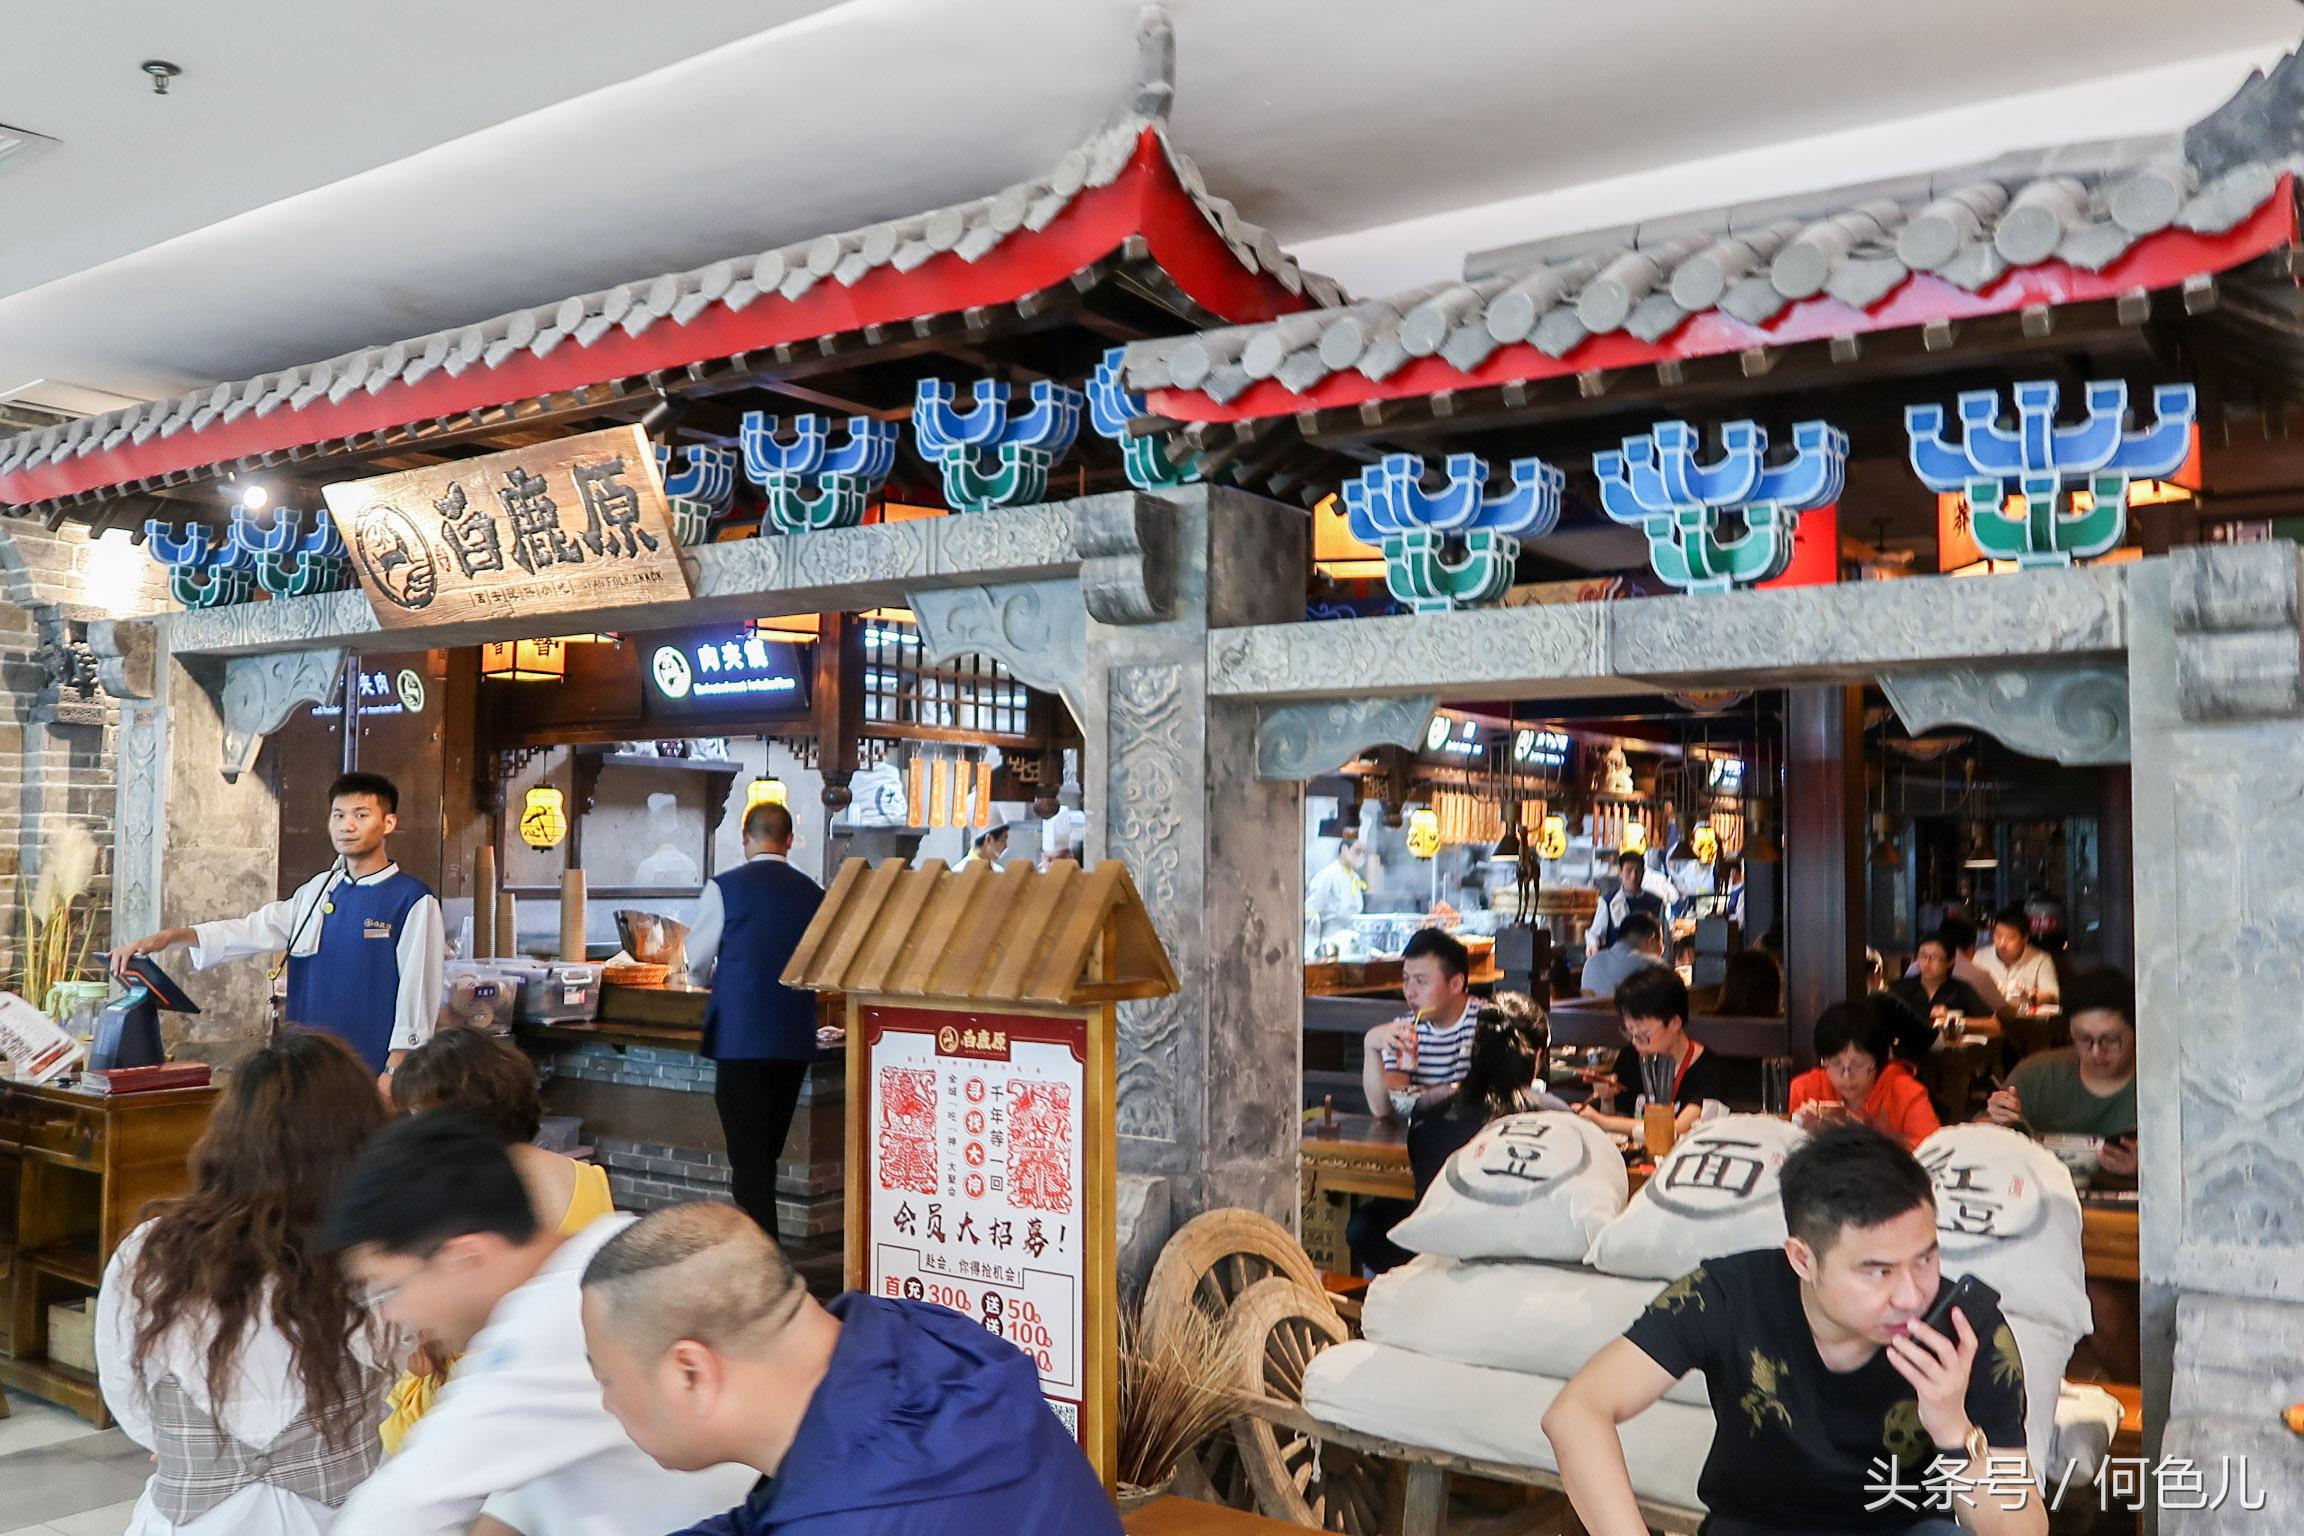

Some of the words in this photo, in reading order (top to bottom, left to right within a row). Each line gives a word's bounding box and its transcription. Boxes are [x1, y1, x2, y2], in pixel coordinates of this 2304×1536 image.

[432, 451, 659, 581] 白鹿原
[633, 570, 665, 585] SNACK
[990, 1085, 1004, 1191] 千年等一回
[1665, 1138, 1764, 1198] 面
